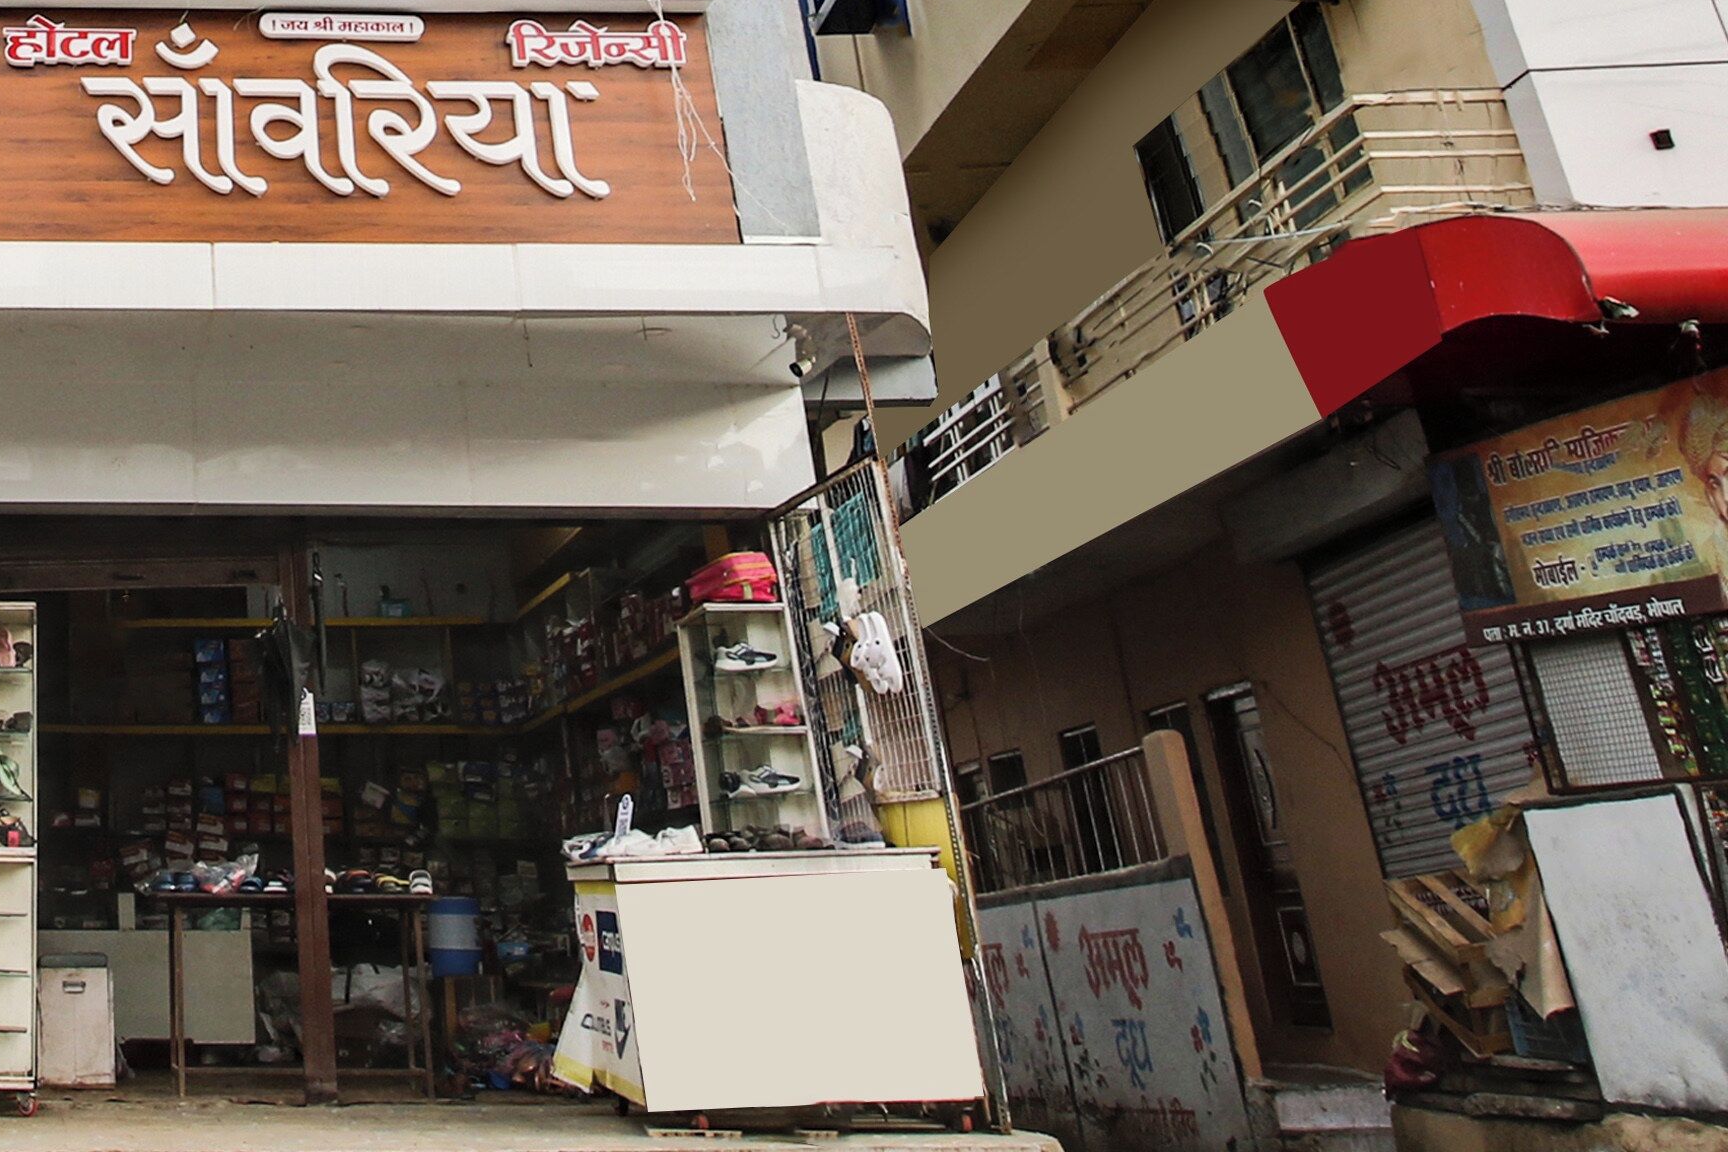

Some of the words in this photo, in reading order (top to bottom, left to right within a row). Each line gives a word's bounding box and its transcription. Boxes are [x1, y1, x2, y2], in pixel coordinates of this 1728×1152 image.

[3, 14, 137, 67] होटल
[506, 19, 687, 68] रिजेन्सी
[280, 19, 309, 32] जय
[313, 16, 334, 32] श्री
[337, 20, 404, 34] महाकाल
[80, 21, 610, 199] साँवरिया
[1646, 596, 1686, 618] भोपाल
